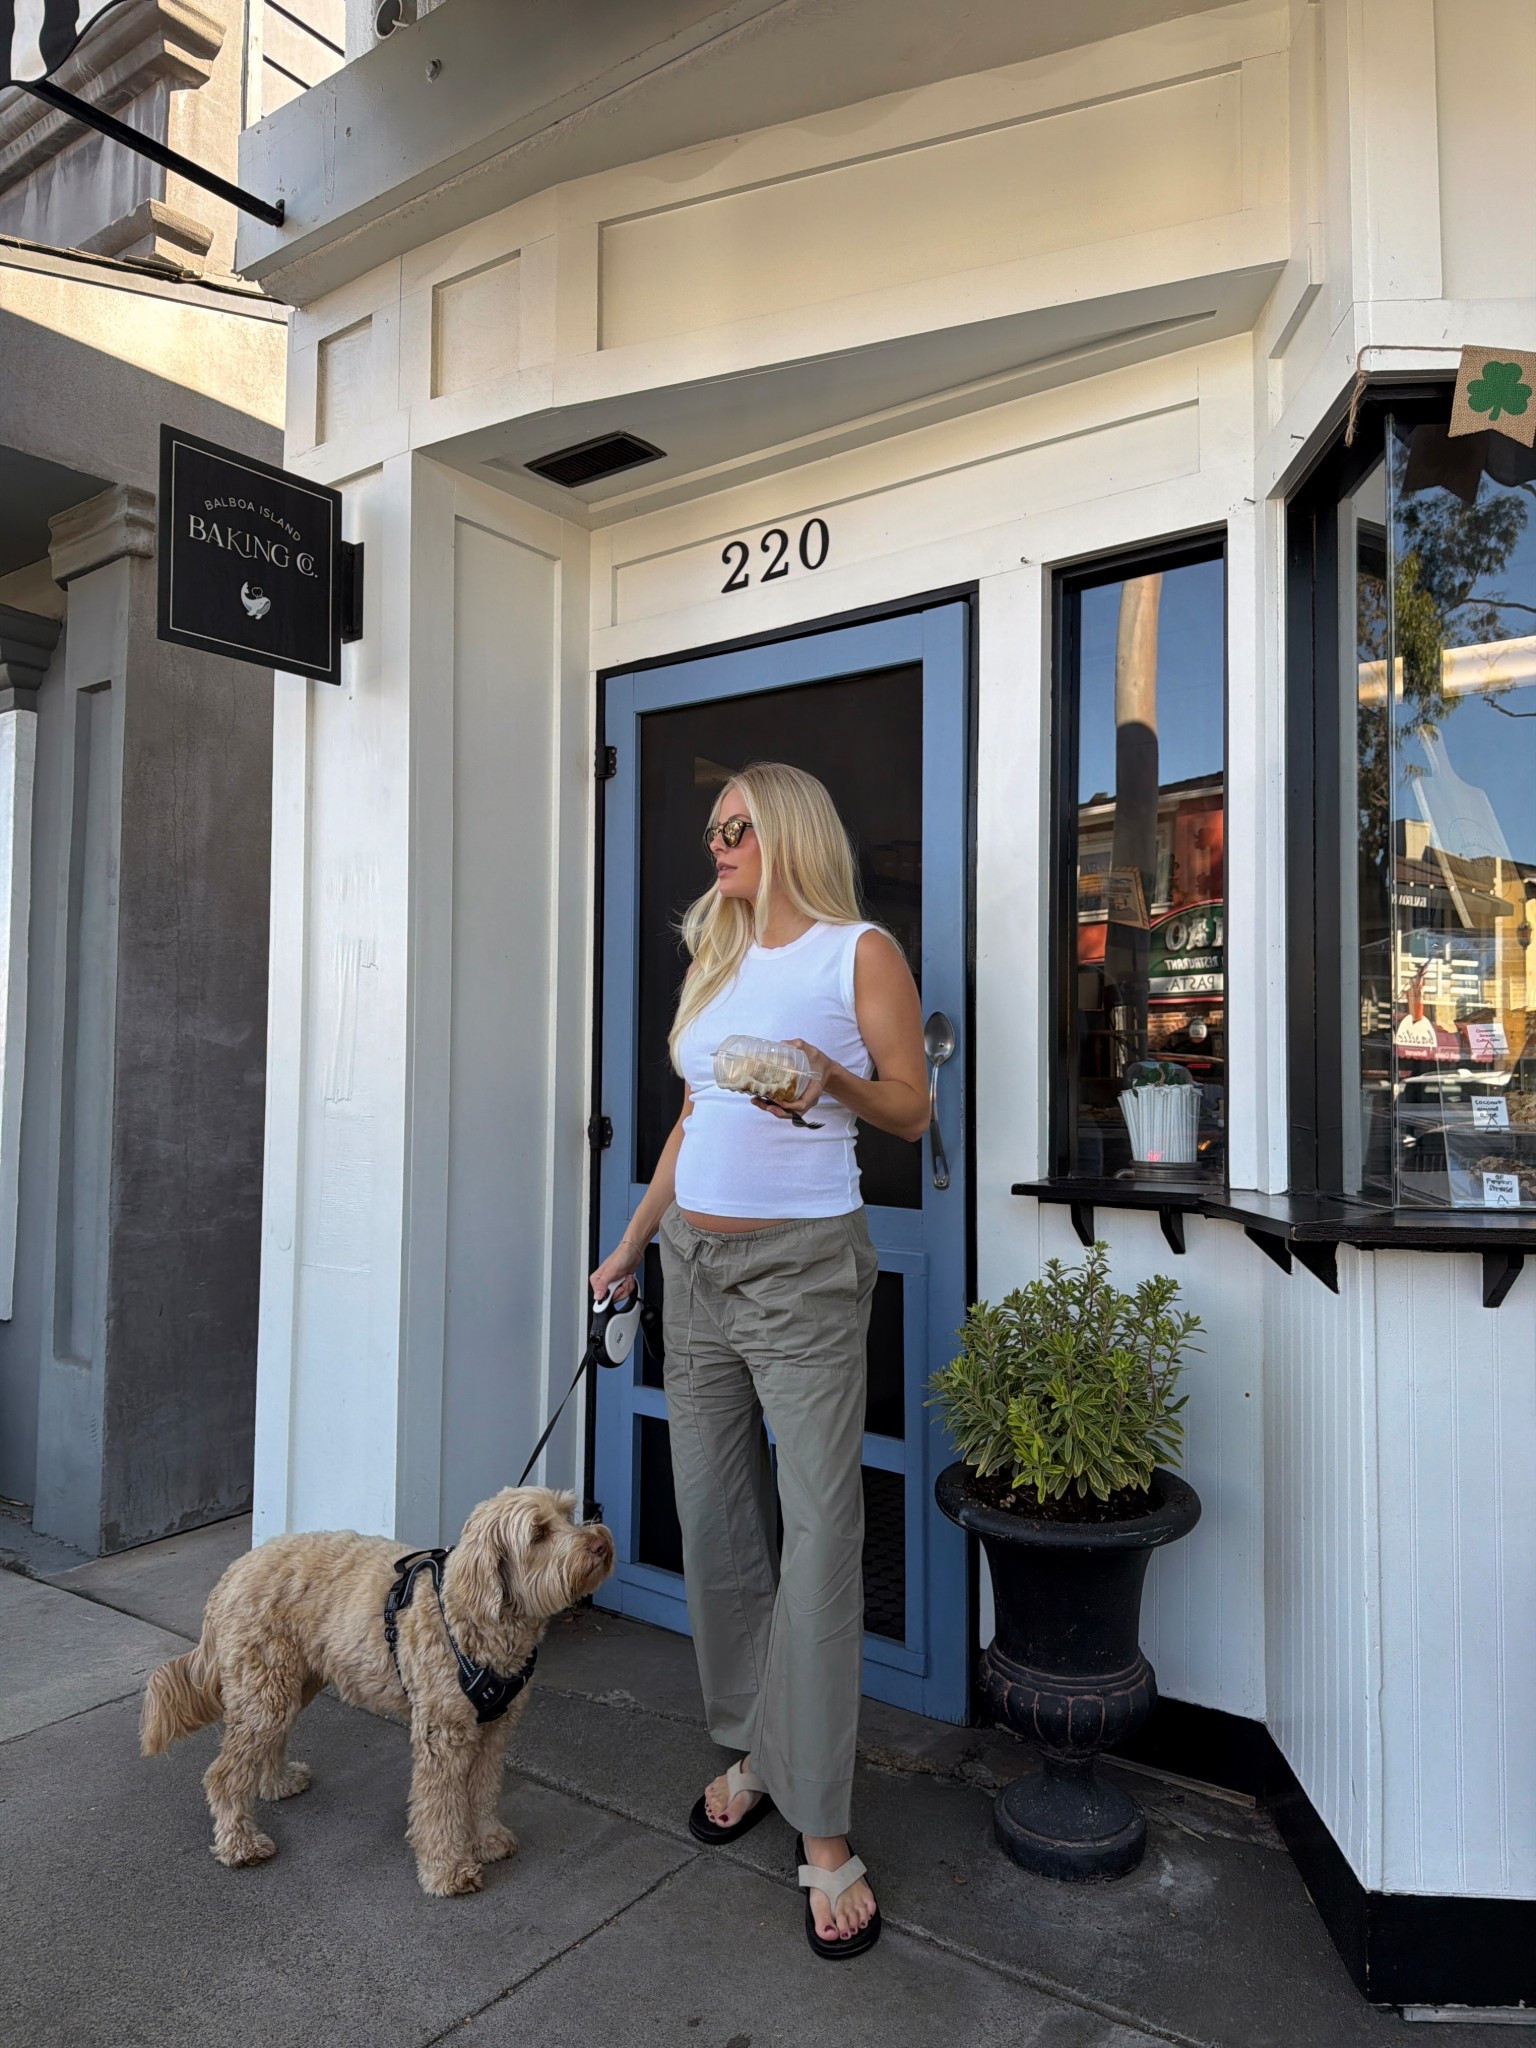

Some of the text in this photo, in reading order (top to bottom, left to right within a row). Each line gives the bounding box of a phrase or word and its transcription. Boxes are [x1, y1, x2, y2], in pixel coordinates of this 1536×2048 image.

[188, 513, 290, 568] BAKING
[204, 497, 301, 542] BALBOA ISLAND
[721, 518, 830, 594] 220
